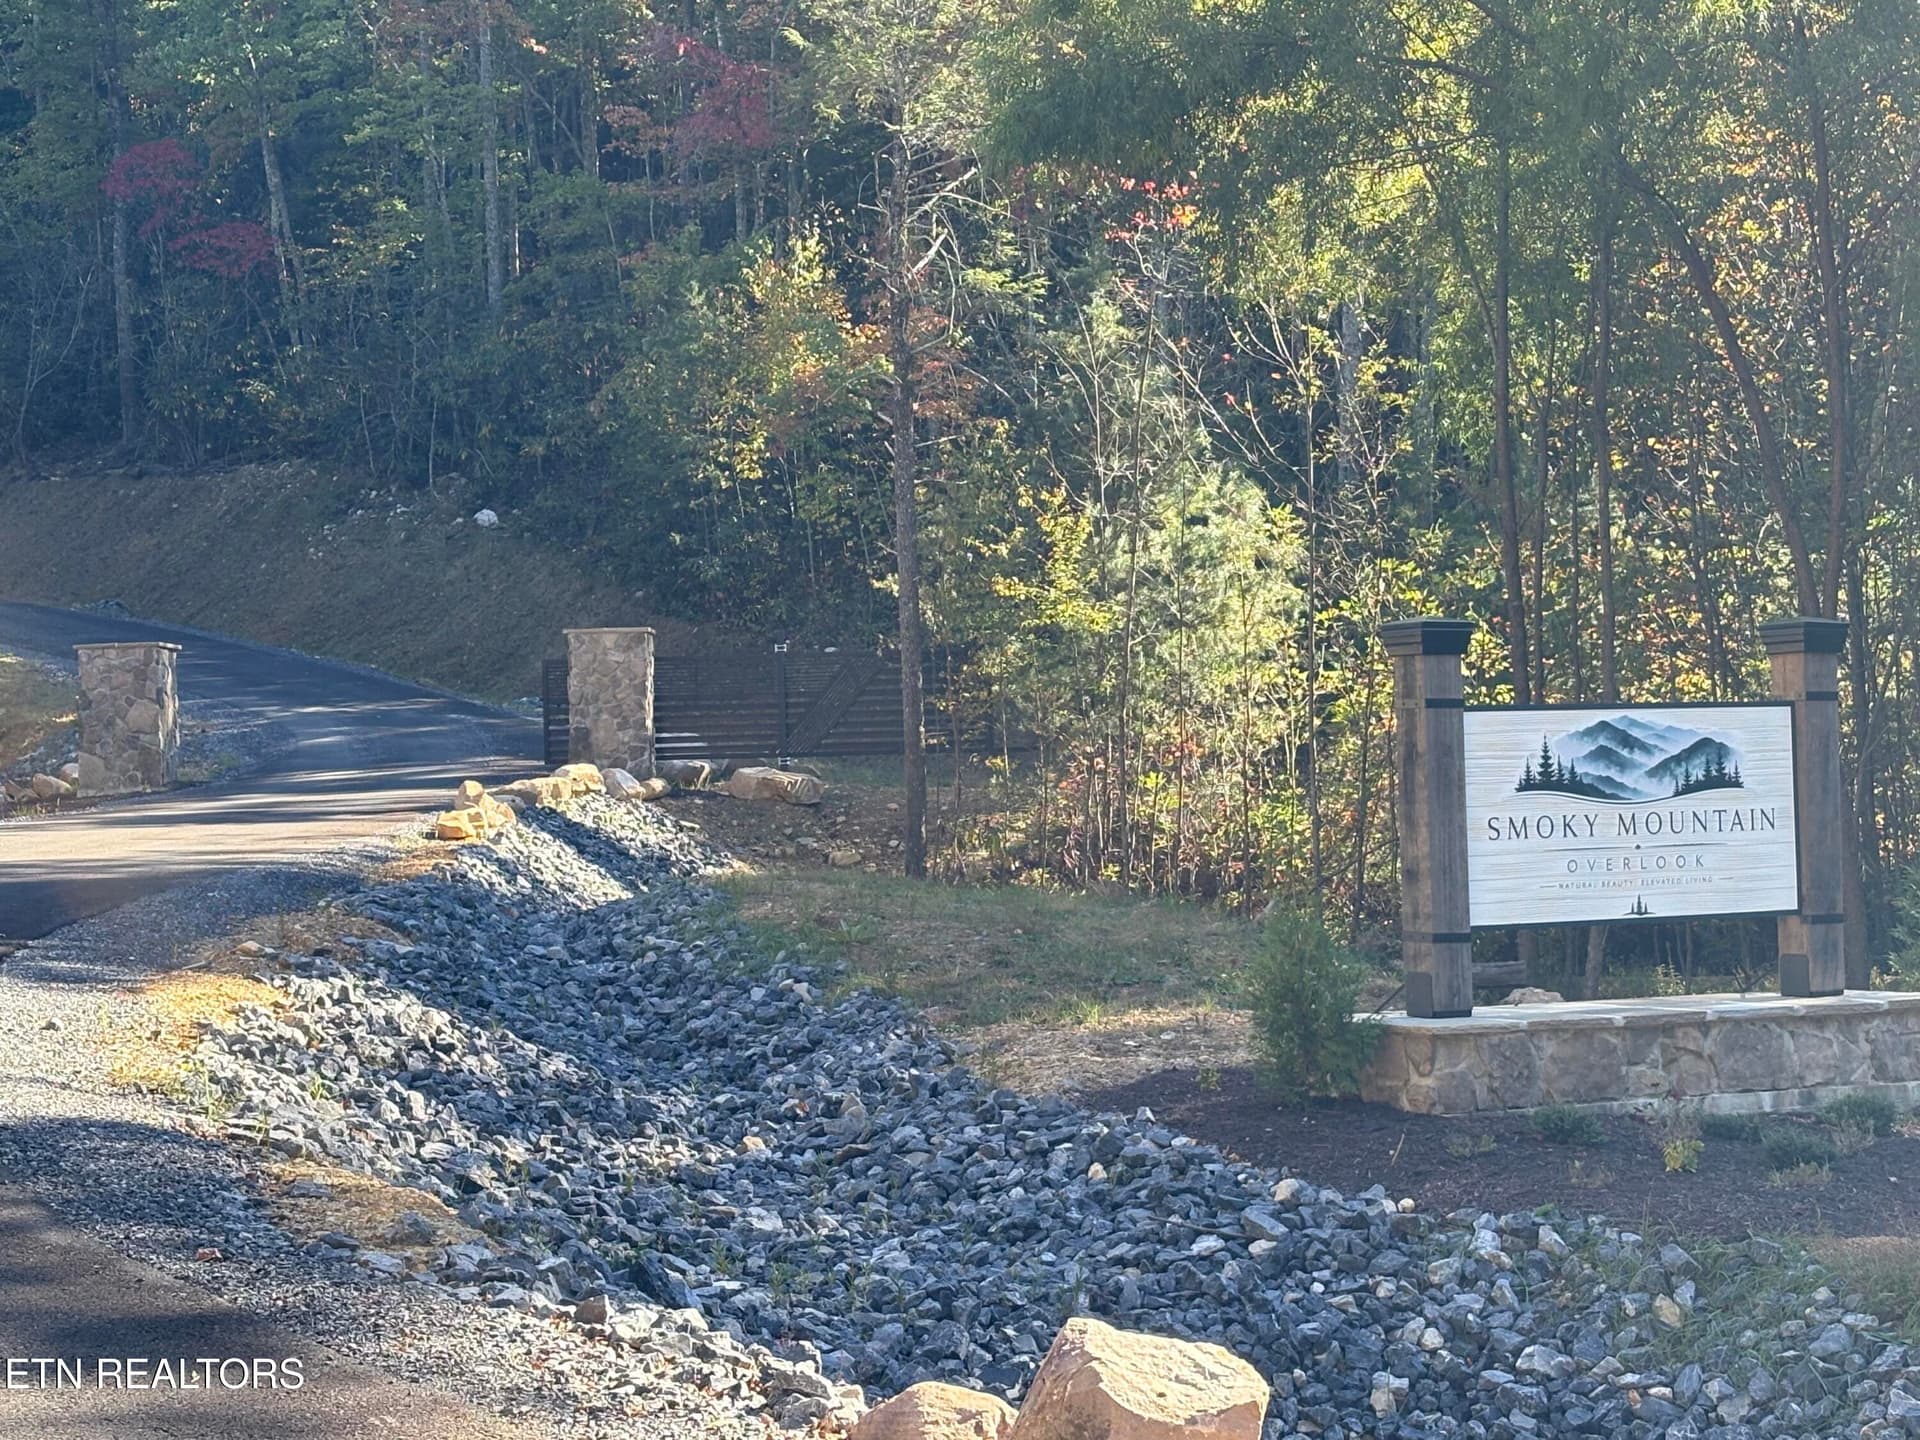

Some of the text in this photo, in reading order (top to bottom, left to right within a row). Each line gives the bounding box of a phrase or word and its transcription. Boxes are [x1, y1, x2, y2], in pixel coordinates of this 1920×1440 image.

[1488, 808, 1777, 841] SMOKY MOUNTAIN
[1567, 854, 1704, 873] OVERLOOK
[1640, 877, 1684, 887] ELEVATED
[1685, 875, 1713, 885] LIVING
